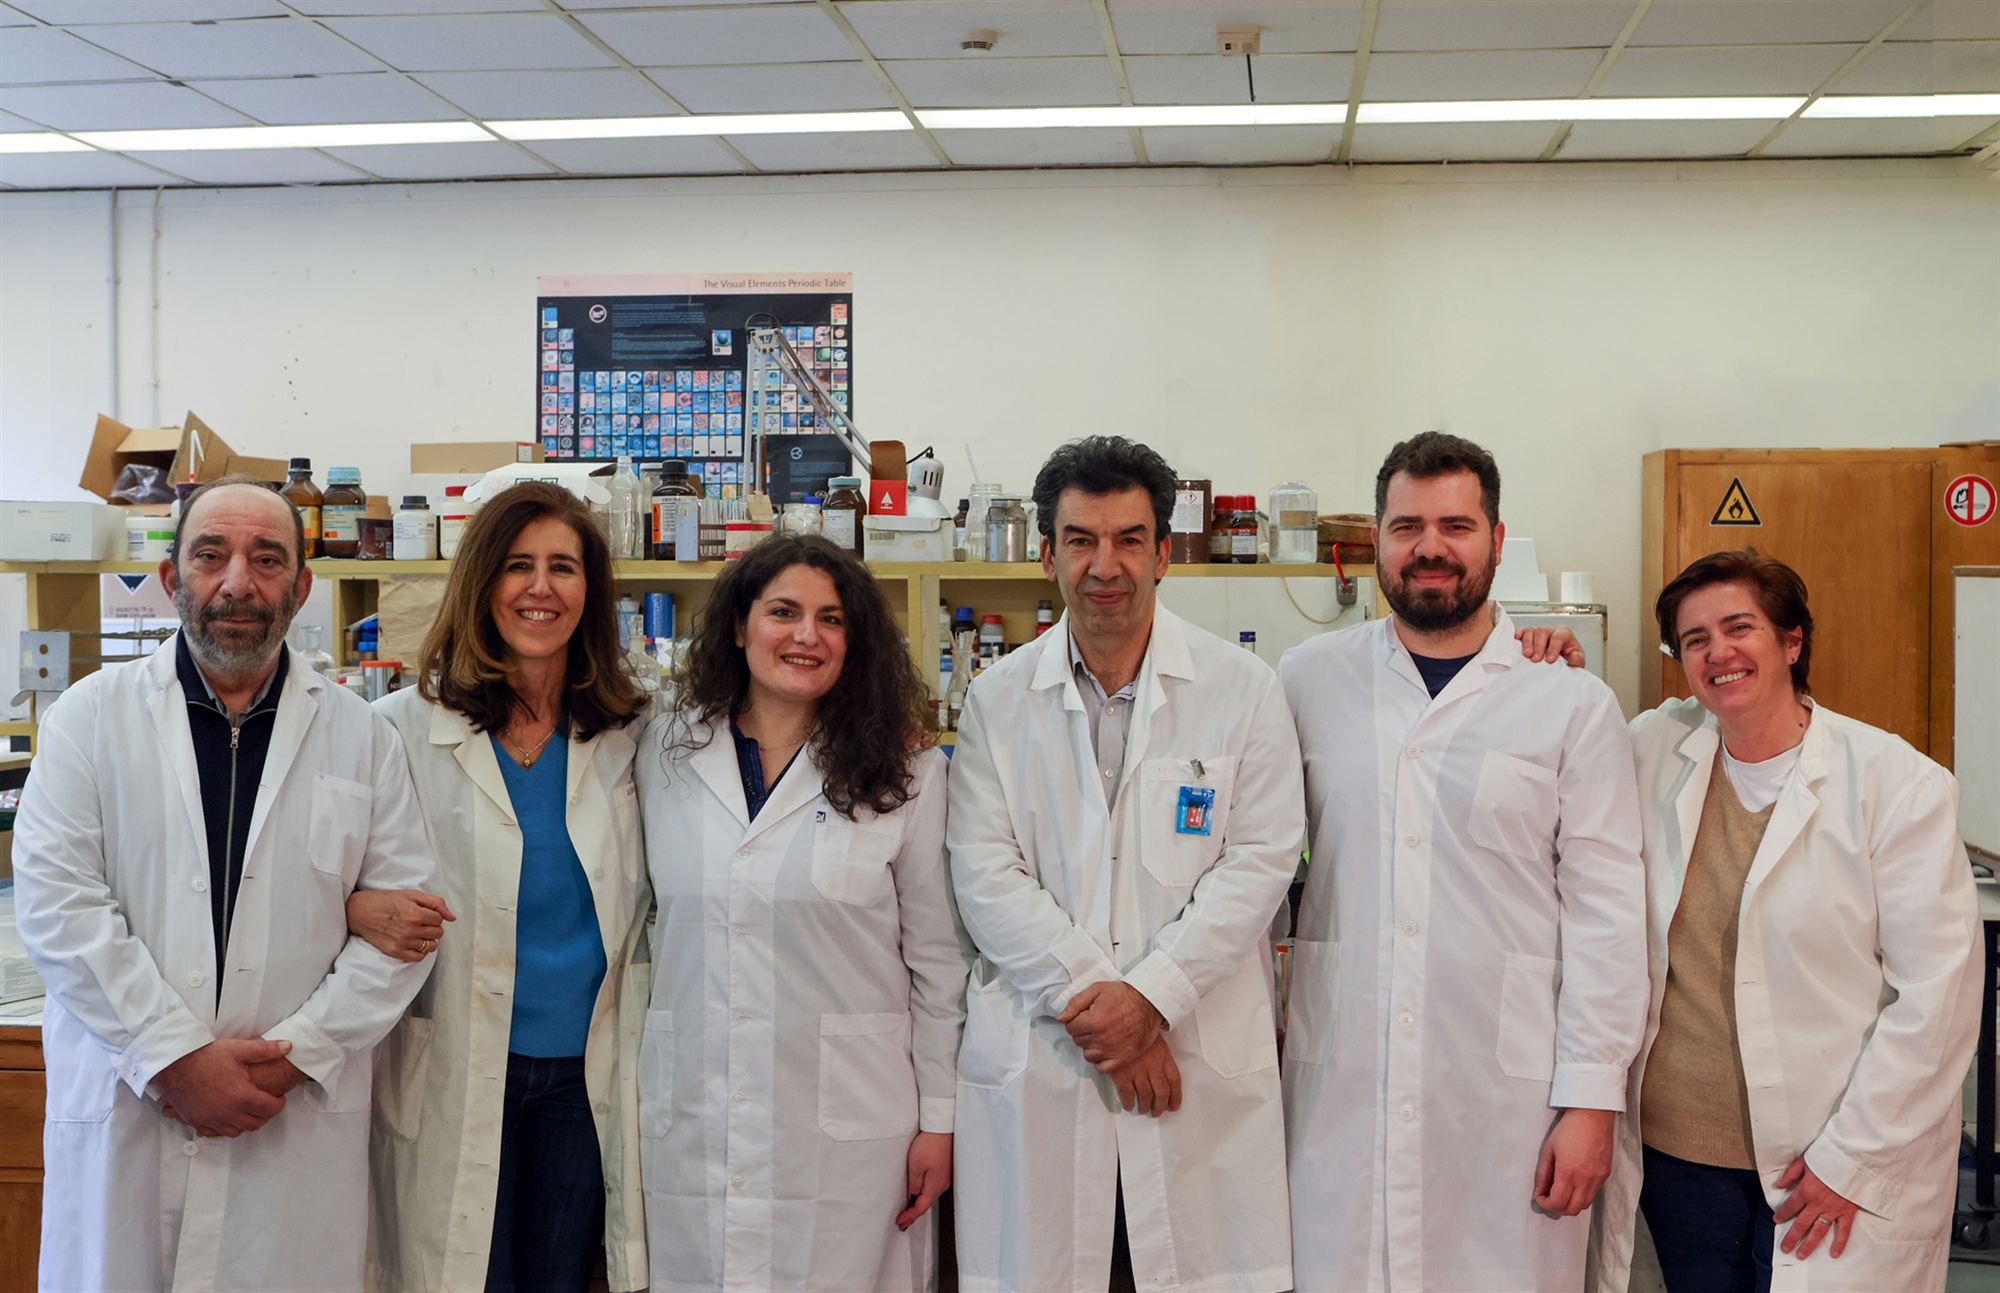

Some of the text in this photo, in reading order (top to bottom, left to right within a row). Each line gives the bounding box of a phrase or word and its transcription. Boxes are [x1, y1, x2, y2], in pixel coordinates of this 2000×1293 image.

[704, 278, 846, 288] The Visual Elements Periodic Table
